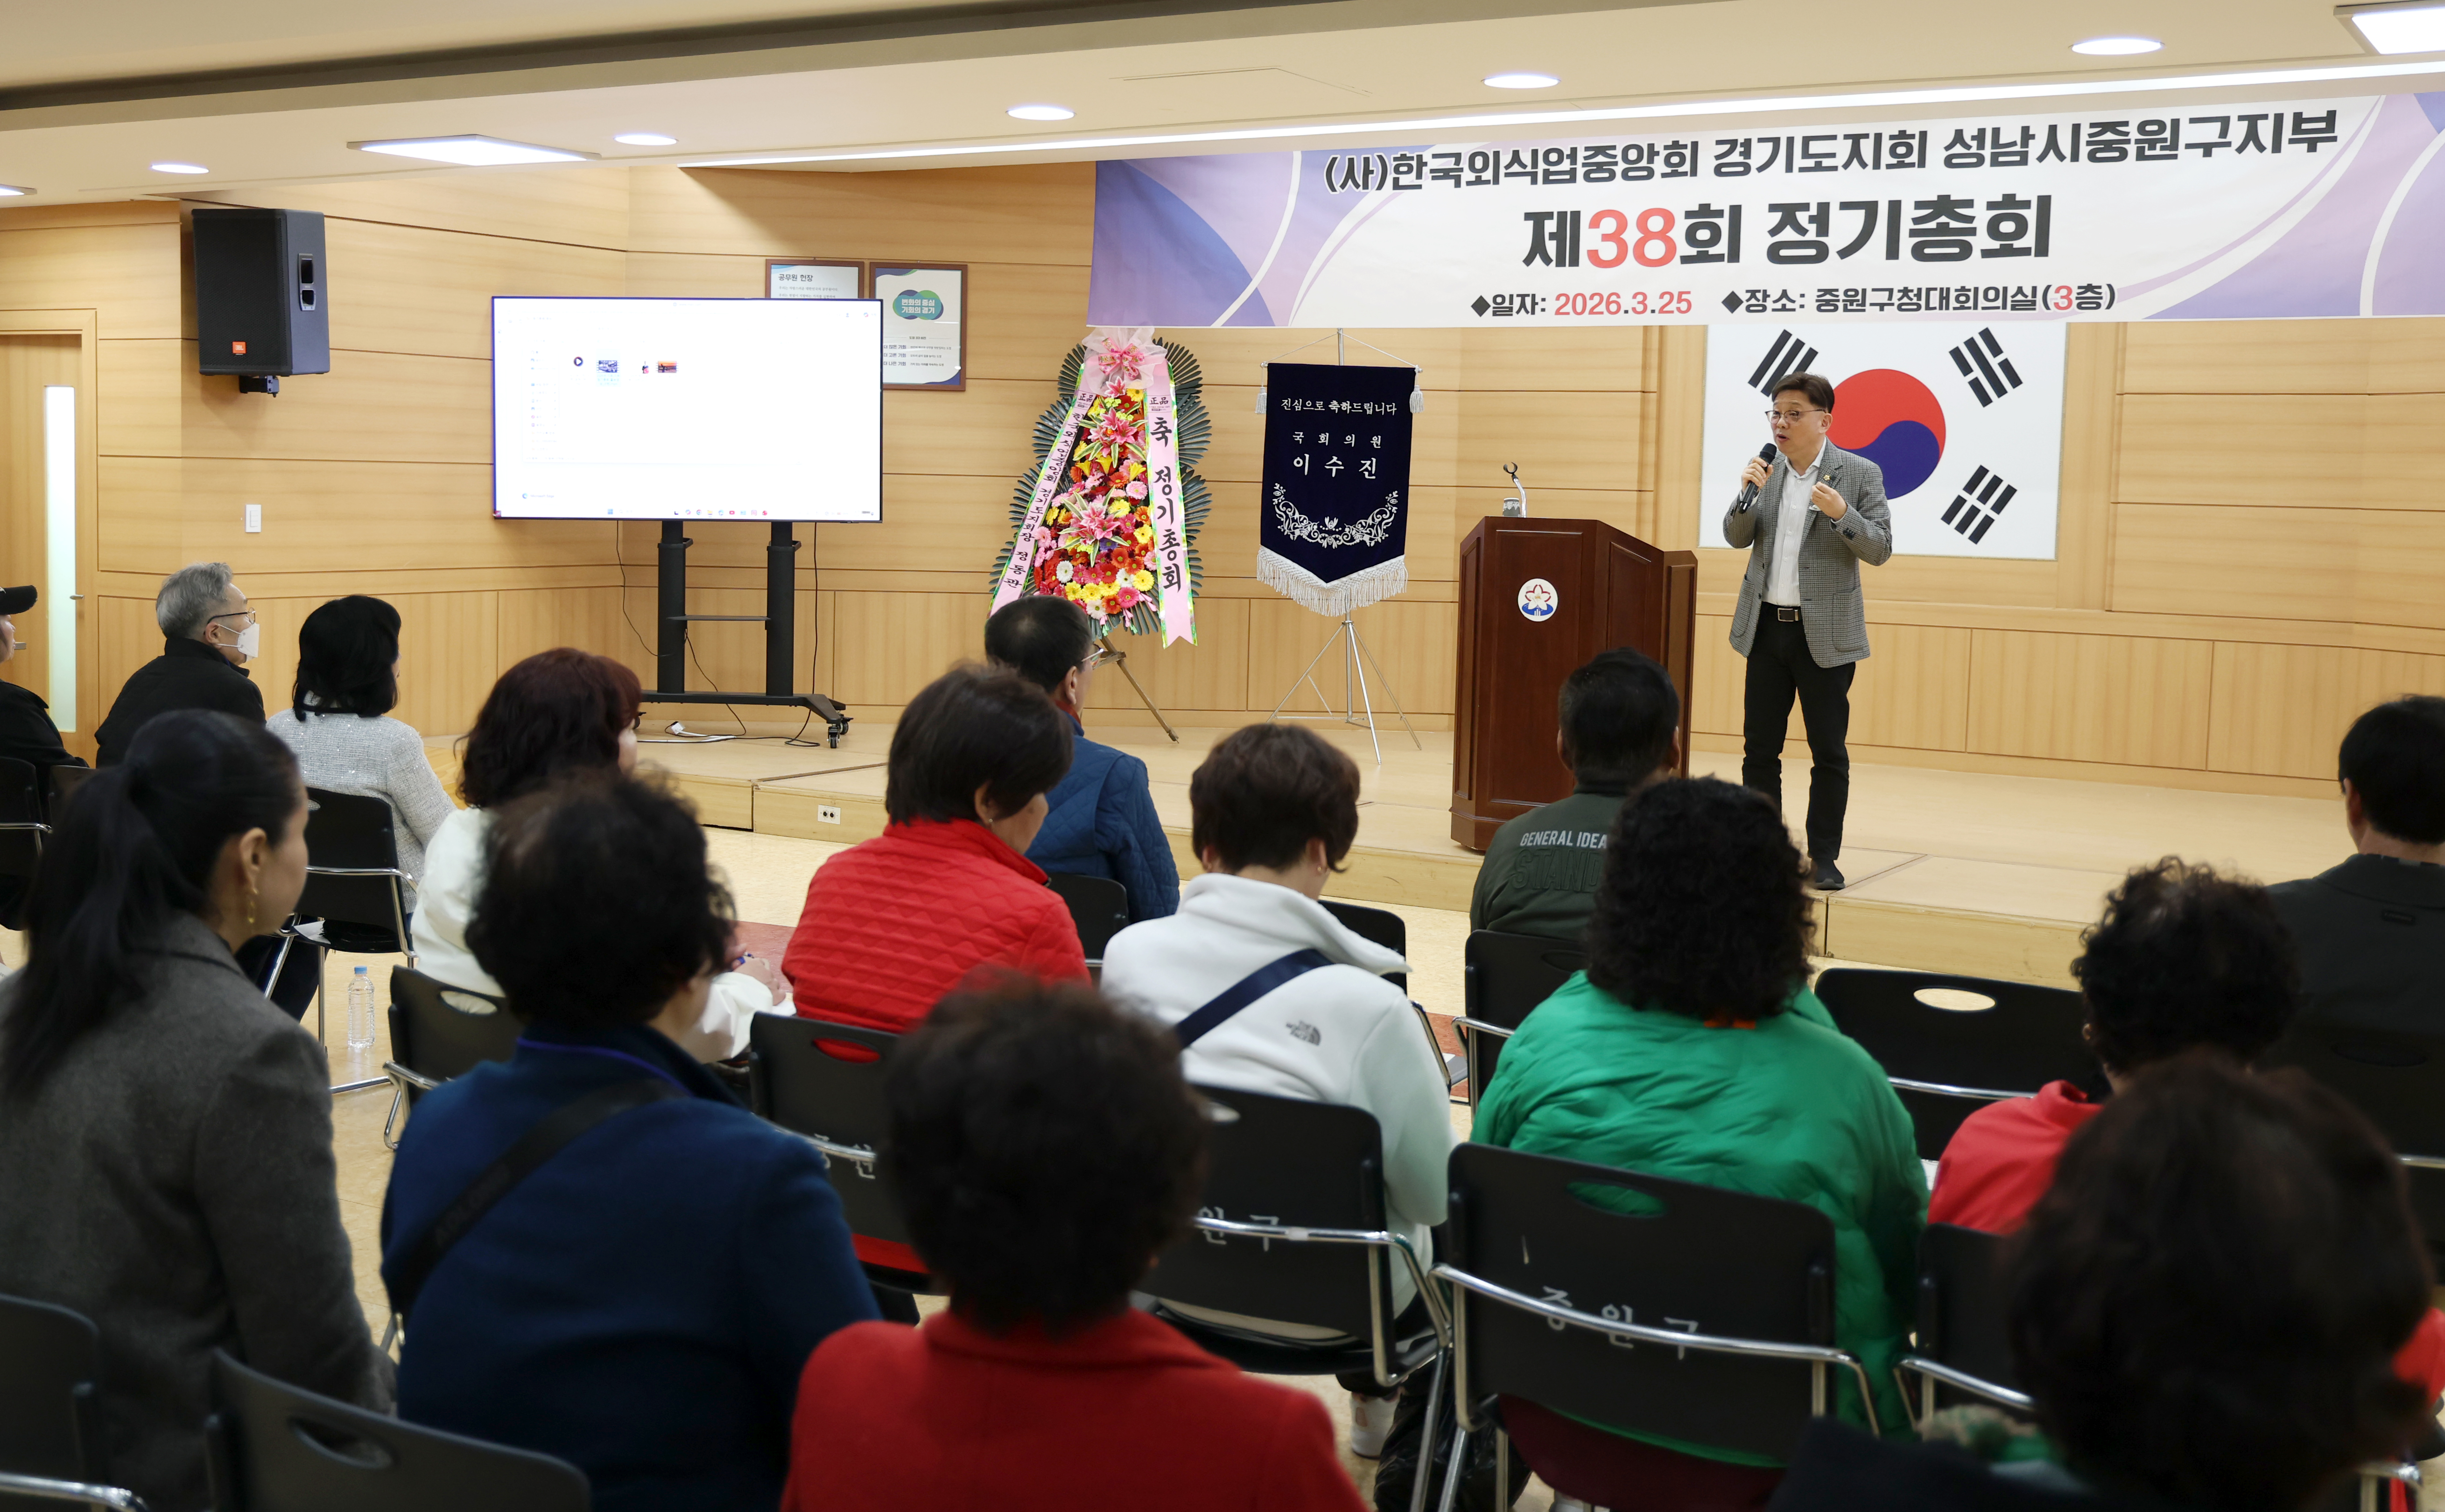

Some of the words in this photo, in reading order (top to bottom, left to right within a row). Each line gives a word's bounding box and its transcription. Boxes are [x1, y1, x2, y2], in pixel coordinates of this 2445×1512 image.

[1325, 140, 1699, 193] (사)한국외식업중앙회
[1714, 129, 1927, 177] 경기도지회
[1943, 109, 2338, 168] 성남시중원구지부
[1523, 203, 1742, 268] 제38회
[1767, 194, 2052, 265] 정기총회
[1492, 294, 1546, 316] 일자:
[1555, 291, 1692, 316] 2026.3.25
[1745, 289, 1806, 312] 장소:
[1815, 283, 2116, 312] 중원구청대회의실(3층)
[1078, 393, 1093, 402] 正品
[1149, 397, 1169, 405] 正品
[1281, 398, 1325, 412] 진심으로
[1328, 400, 1398, 415] 축하드립니다
[1150, 417, 1173, 448] 축
[1293, 431, 1382, 449] 국회의원
[1293, 454, 1377, 479] 이수진
[1153, 466, 1181, 593] 정기총회
[1520, 830, 1573, 846] GENERAL
[1576, 831, 1608, 848] IDEA
